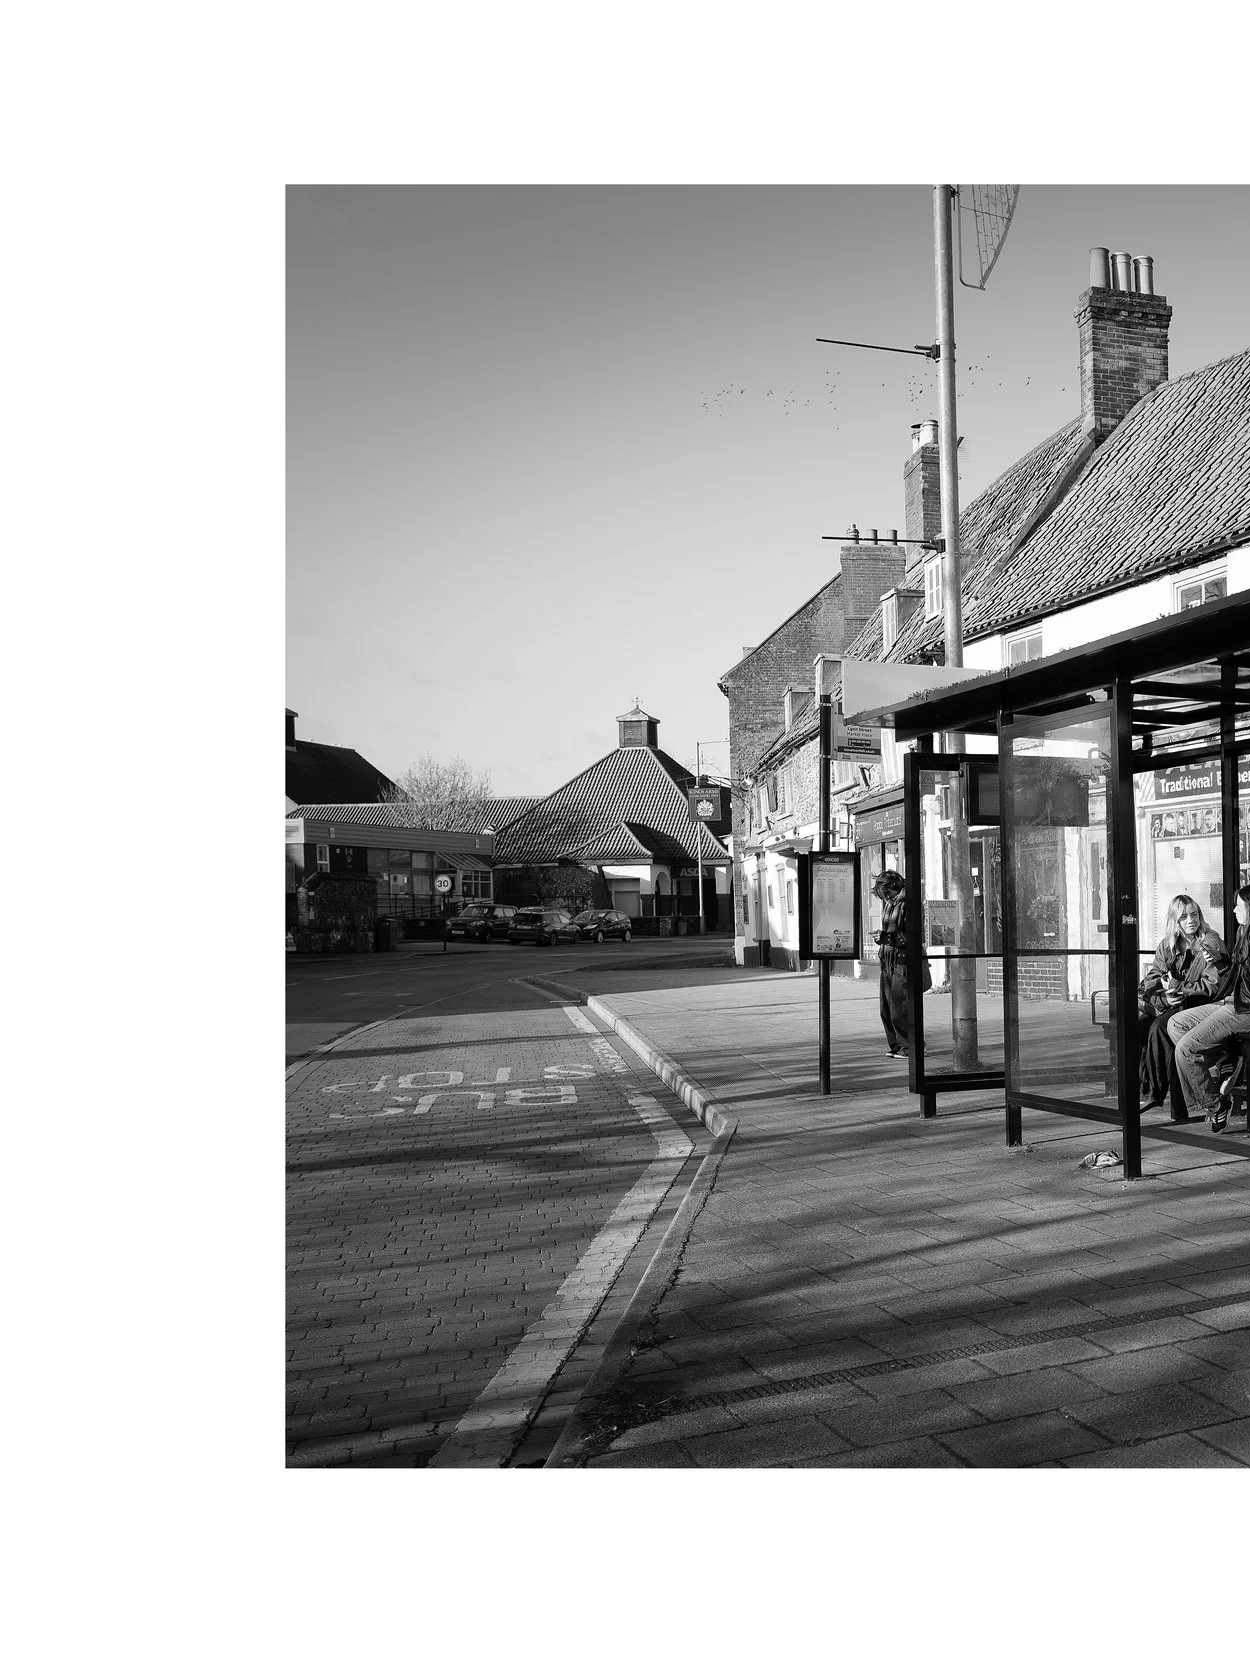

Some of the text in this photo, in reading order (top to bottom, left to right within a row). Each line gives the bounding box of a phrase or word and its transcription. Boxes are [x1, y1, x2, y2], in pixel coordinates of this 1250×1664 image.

[1160, 771, 1214, 794] Traditional
[679, 867, 709, 877] ASDA
[436, 880, 449, 888] 30
